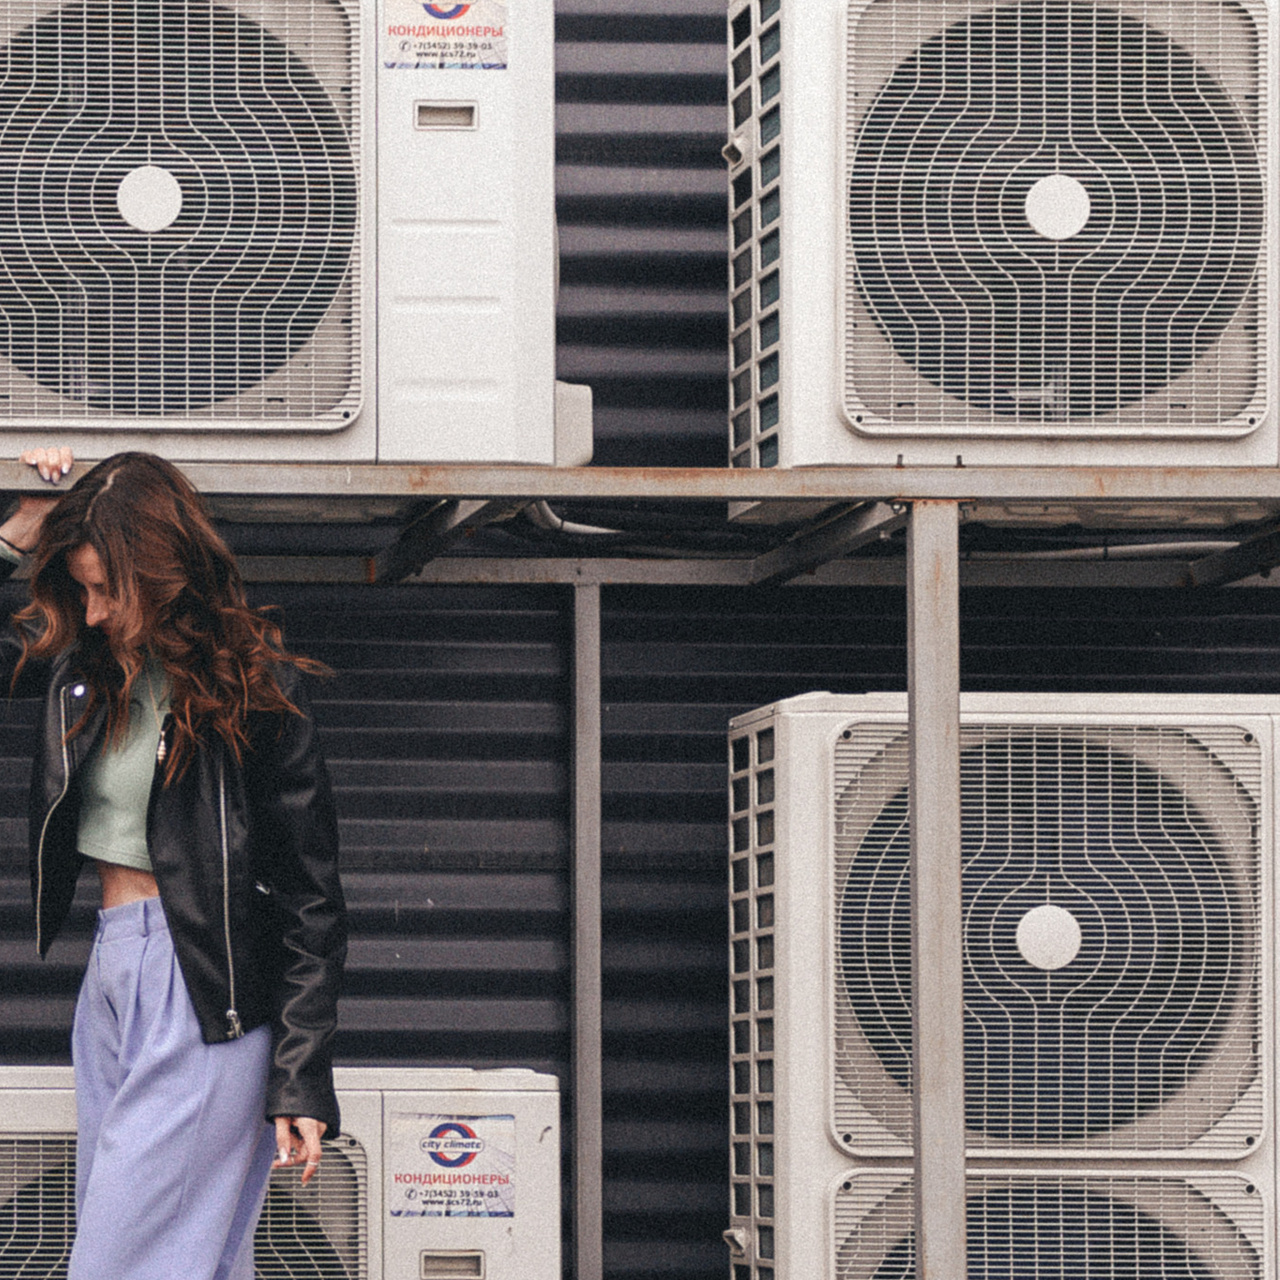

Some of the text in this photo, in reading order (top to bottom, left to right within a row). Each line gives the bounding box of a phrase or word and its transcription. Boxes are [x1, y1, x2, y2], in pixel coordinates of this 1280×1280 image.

[387, 24, 504, 38] КОНДИЦИОНЕРЫ
[421, 1140, 482, 1150] city climate
[394, 1173, 510, 1186] КОНДИЦИОНЕРЫ
